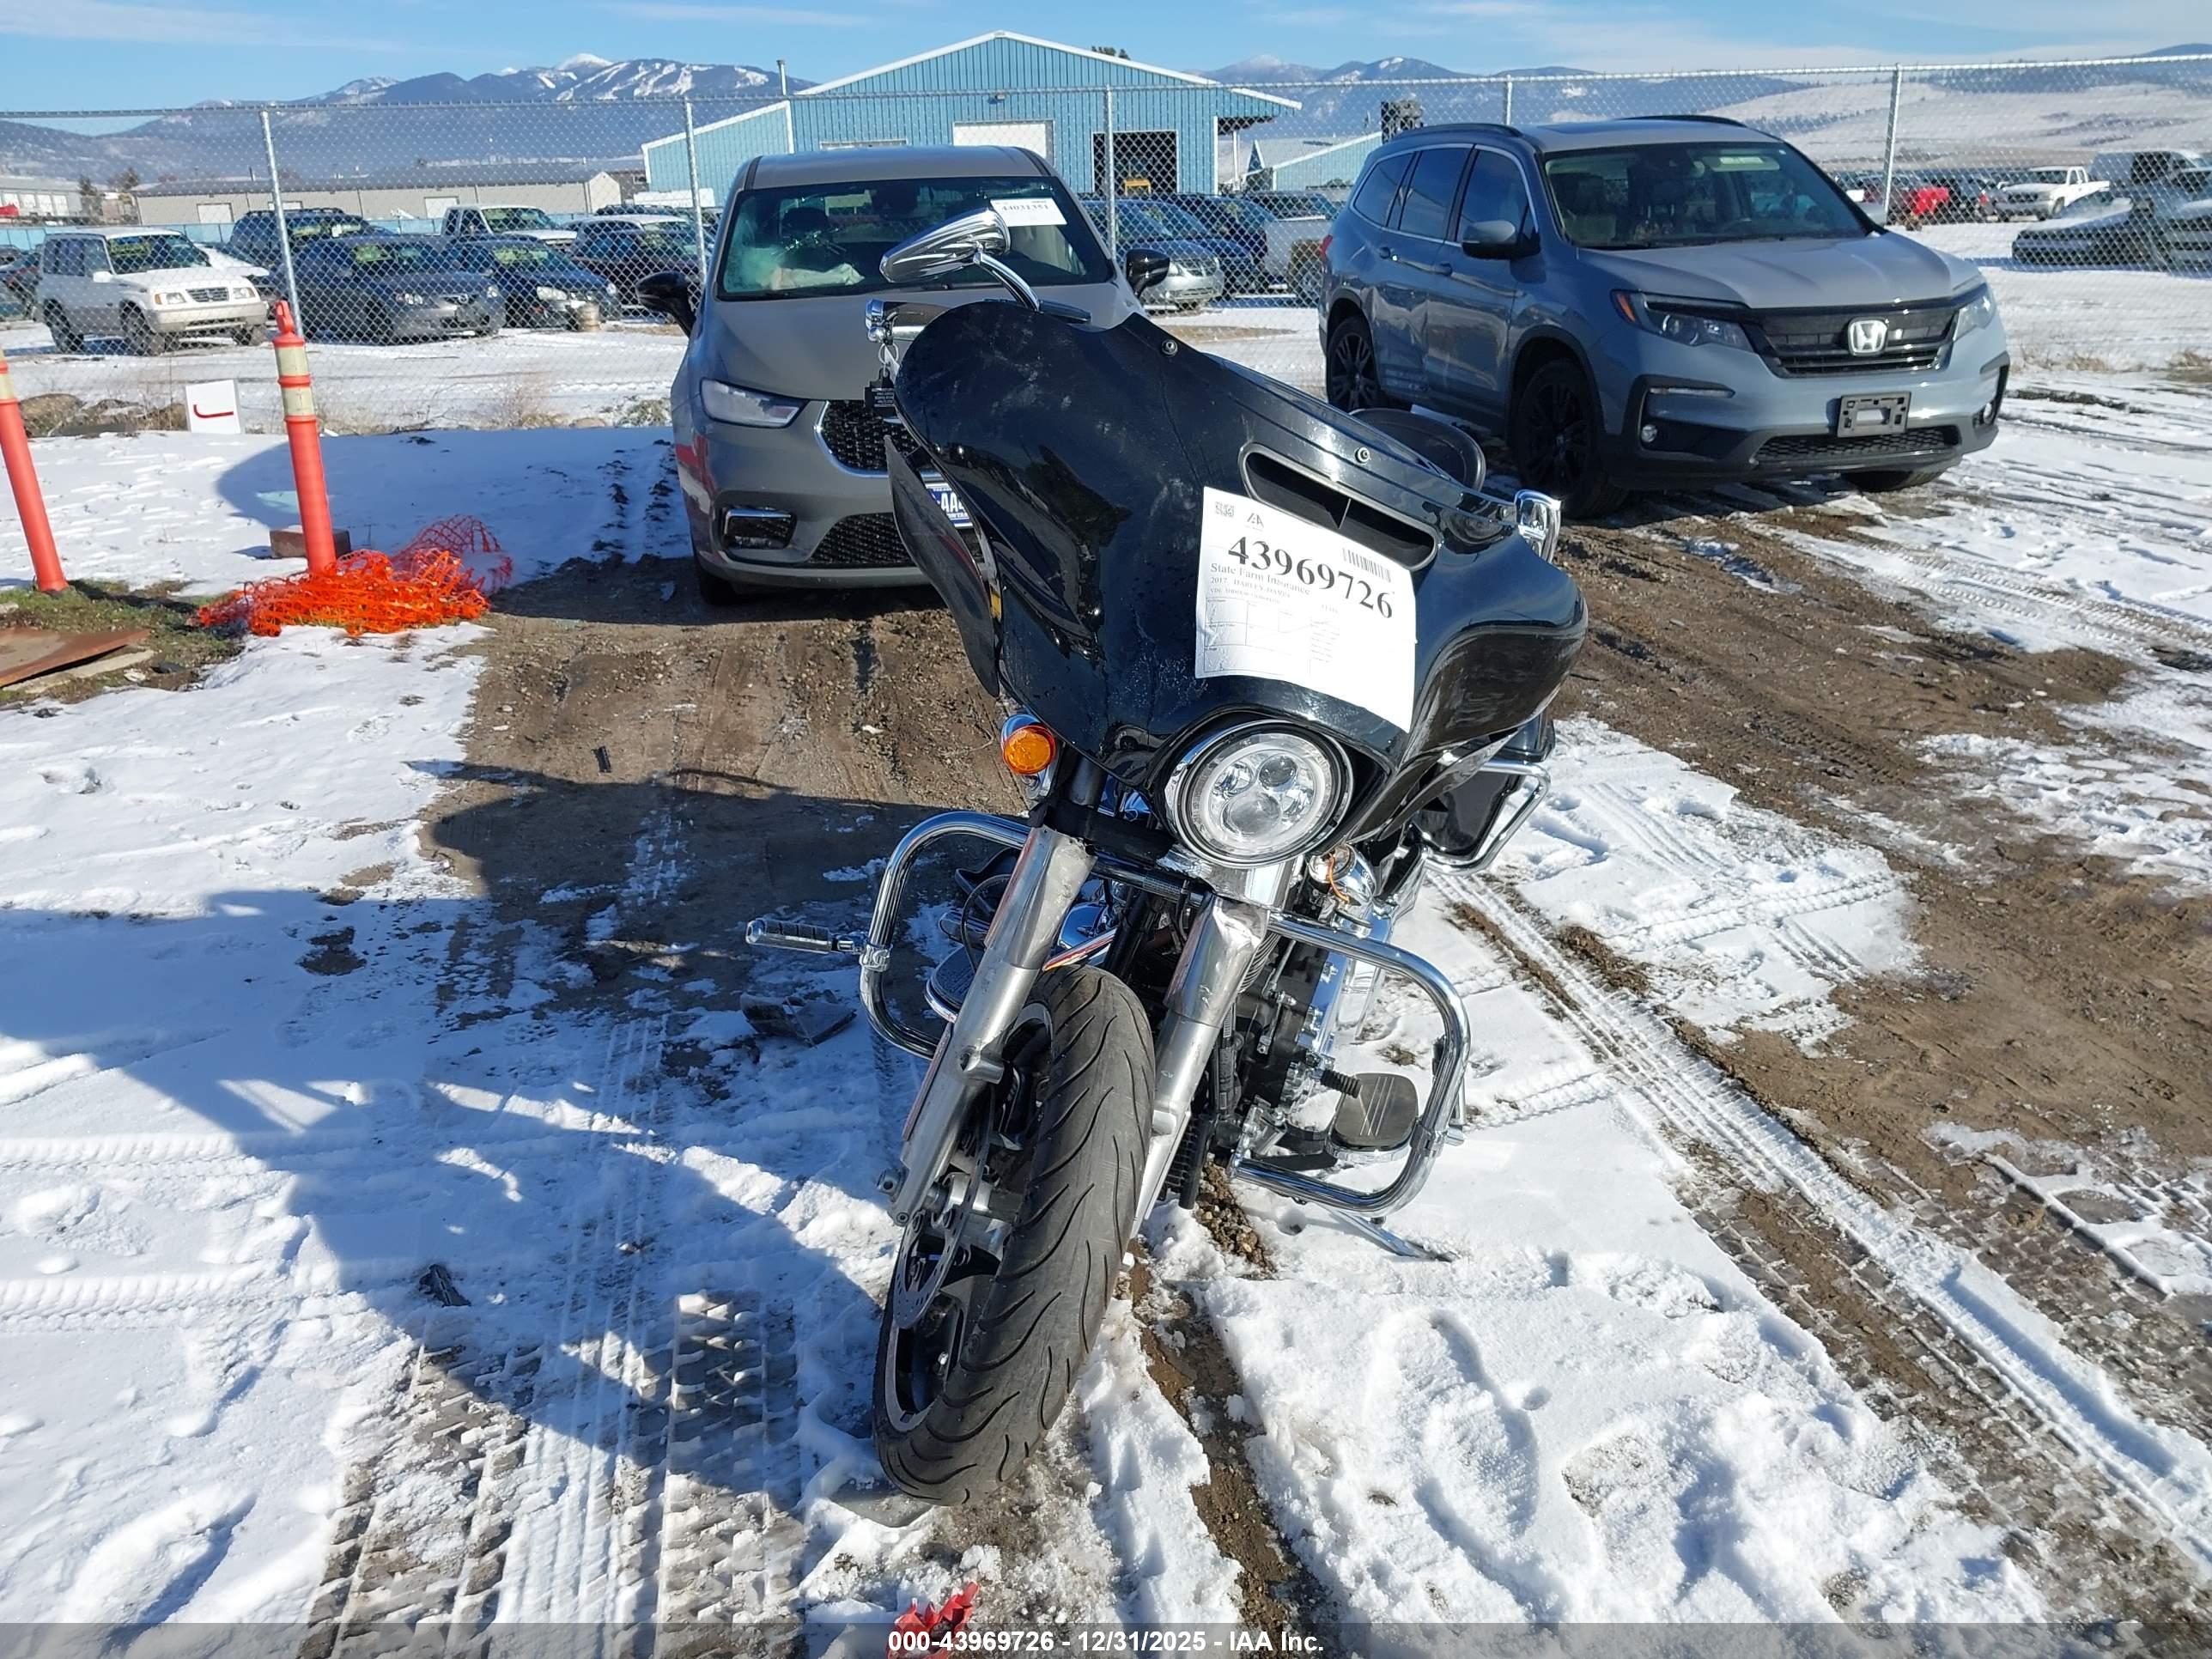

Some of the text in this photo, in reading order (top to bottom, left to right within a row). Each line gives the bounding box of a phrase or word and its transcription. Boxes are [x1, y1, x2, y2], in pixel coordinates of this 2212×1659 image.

[1210, 562, 1237, 574] State
[1239, 567, 1264, 581] Farm
[1228, 536, 1395, 618] 43969726
